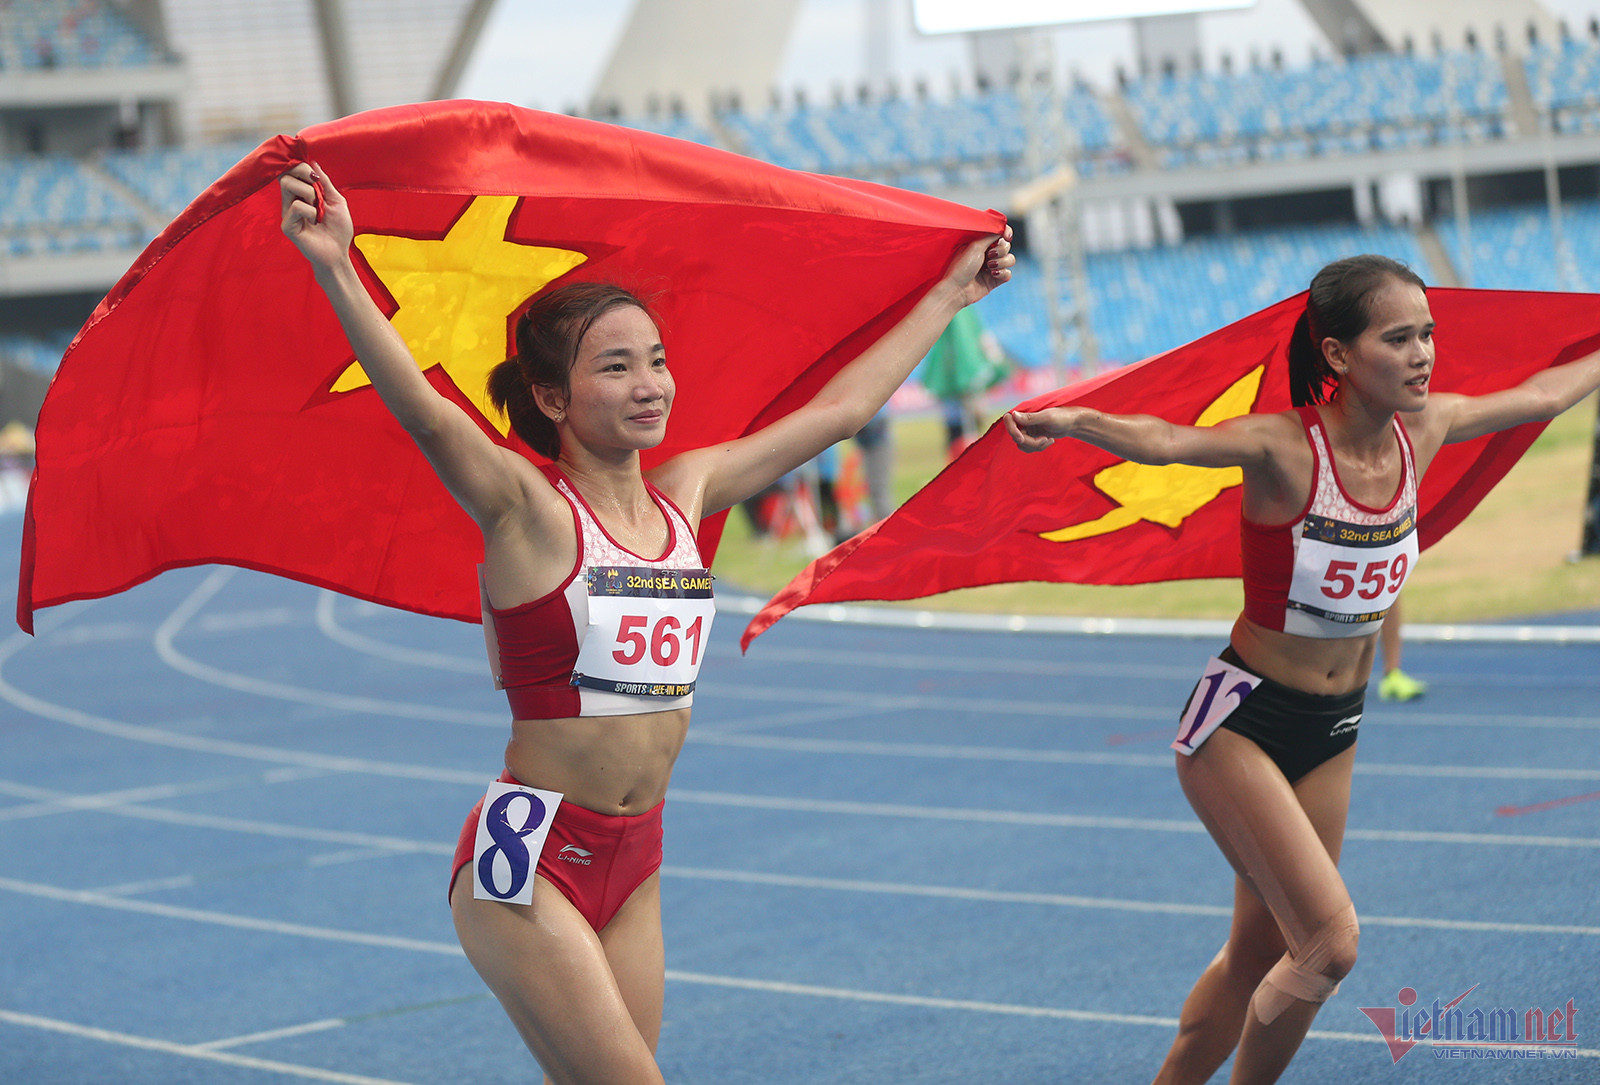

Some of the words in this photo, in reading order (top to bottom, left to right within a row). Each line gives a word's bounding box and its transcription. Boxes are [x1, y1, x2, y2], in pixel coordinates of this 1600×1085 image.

[1340, 529, 1370, 542] 32nd
[1371, 529, 1392, 542] SEA
[627, 576, 654, 589] 32nd
[655, 577, 678, 590] SEA
[1320, 553, 1408, 600] 559
[612, 615, 703, 667] 561
[614, 682, 647, 695] SPORTS
[478, 791, 546, 899] 8
[557, 853, 592, 866] LI-NING
